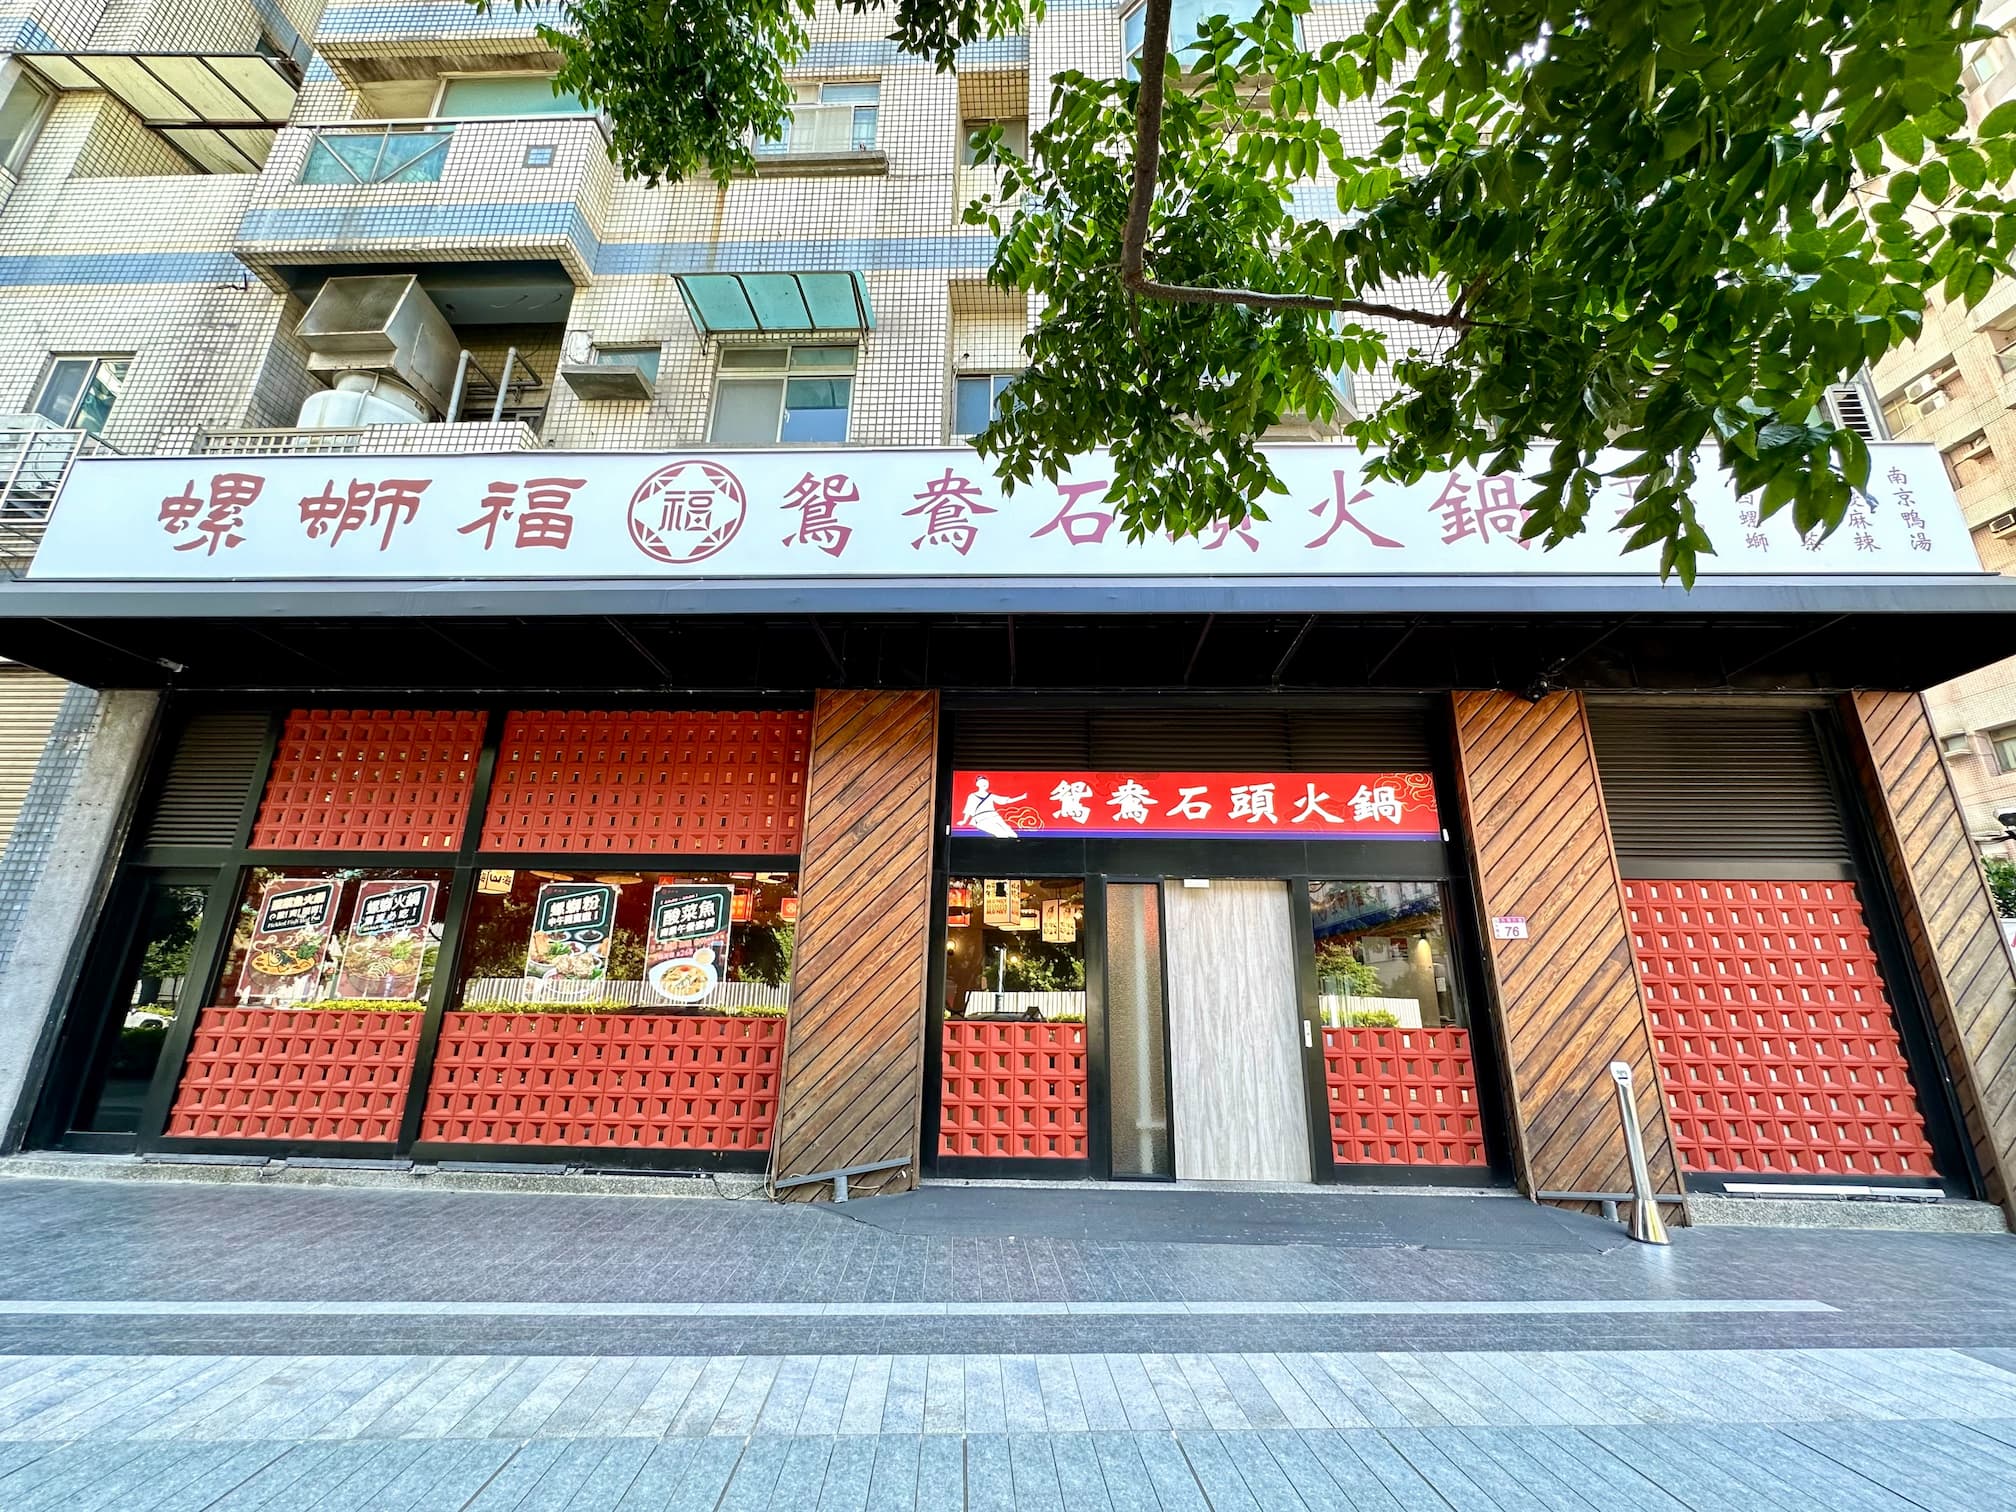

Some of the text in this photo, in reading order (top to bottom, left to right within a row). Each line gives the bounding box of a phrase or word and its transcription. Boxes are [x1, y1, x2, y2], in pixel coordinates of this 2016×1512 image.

[658, 490, 716, 531] 福
[782, 467, 1532, 558] 鴛鴦石火鍋
[1887, 466, 1933, 552] 南京鴨湯
[1048, 778, 1404, 825] 鴛鴦石頭火鍋
[662, 900, 715, 927] 酸菜魚
[1504, 926, 1520, 937] 76
